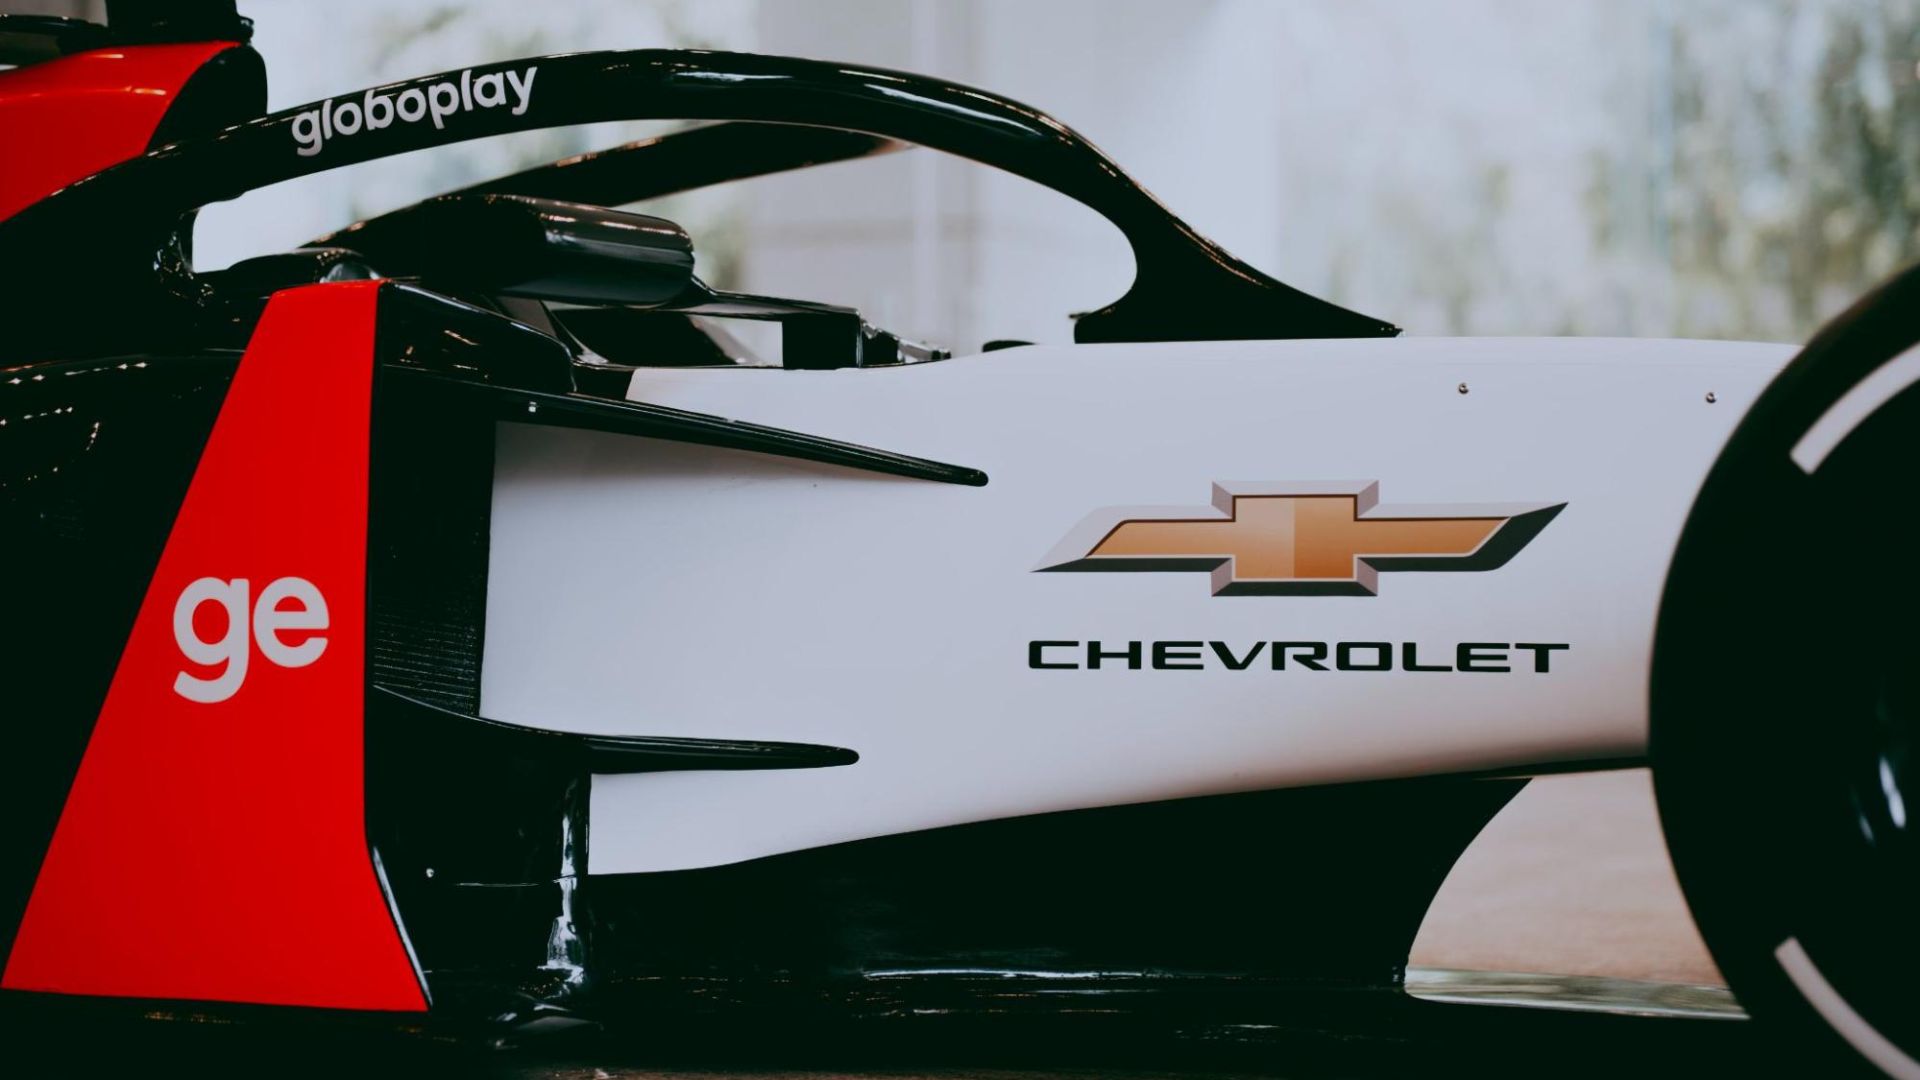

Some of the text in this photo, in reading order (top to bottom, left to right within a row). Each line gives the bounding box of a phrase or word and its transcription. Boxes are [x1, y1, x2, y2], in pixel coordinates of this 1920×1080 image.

[291, 66, 538, 157] globoplay
[172, 576, 330, 704] ge
[1028, 640, 1570, 673] CHEVROLET
